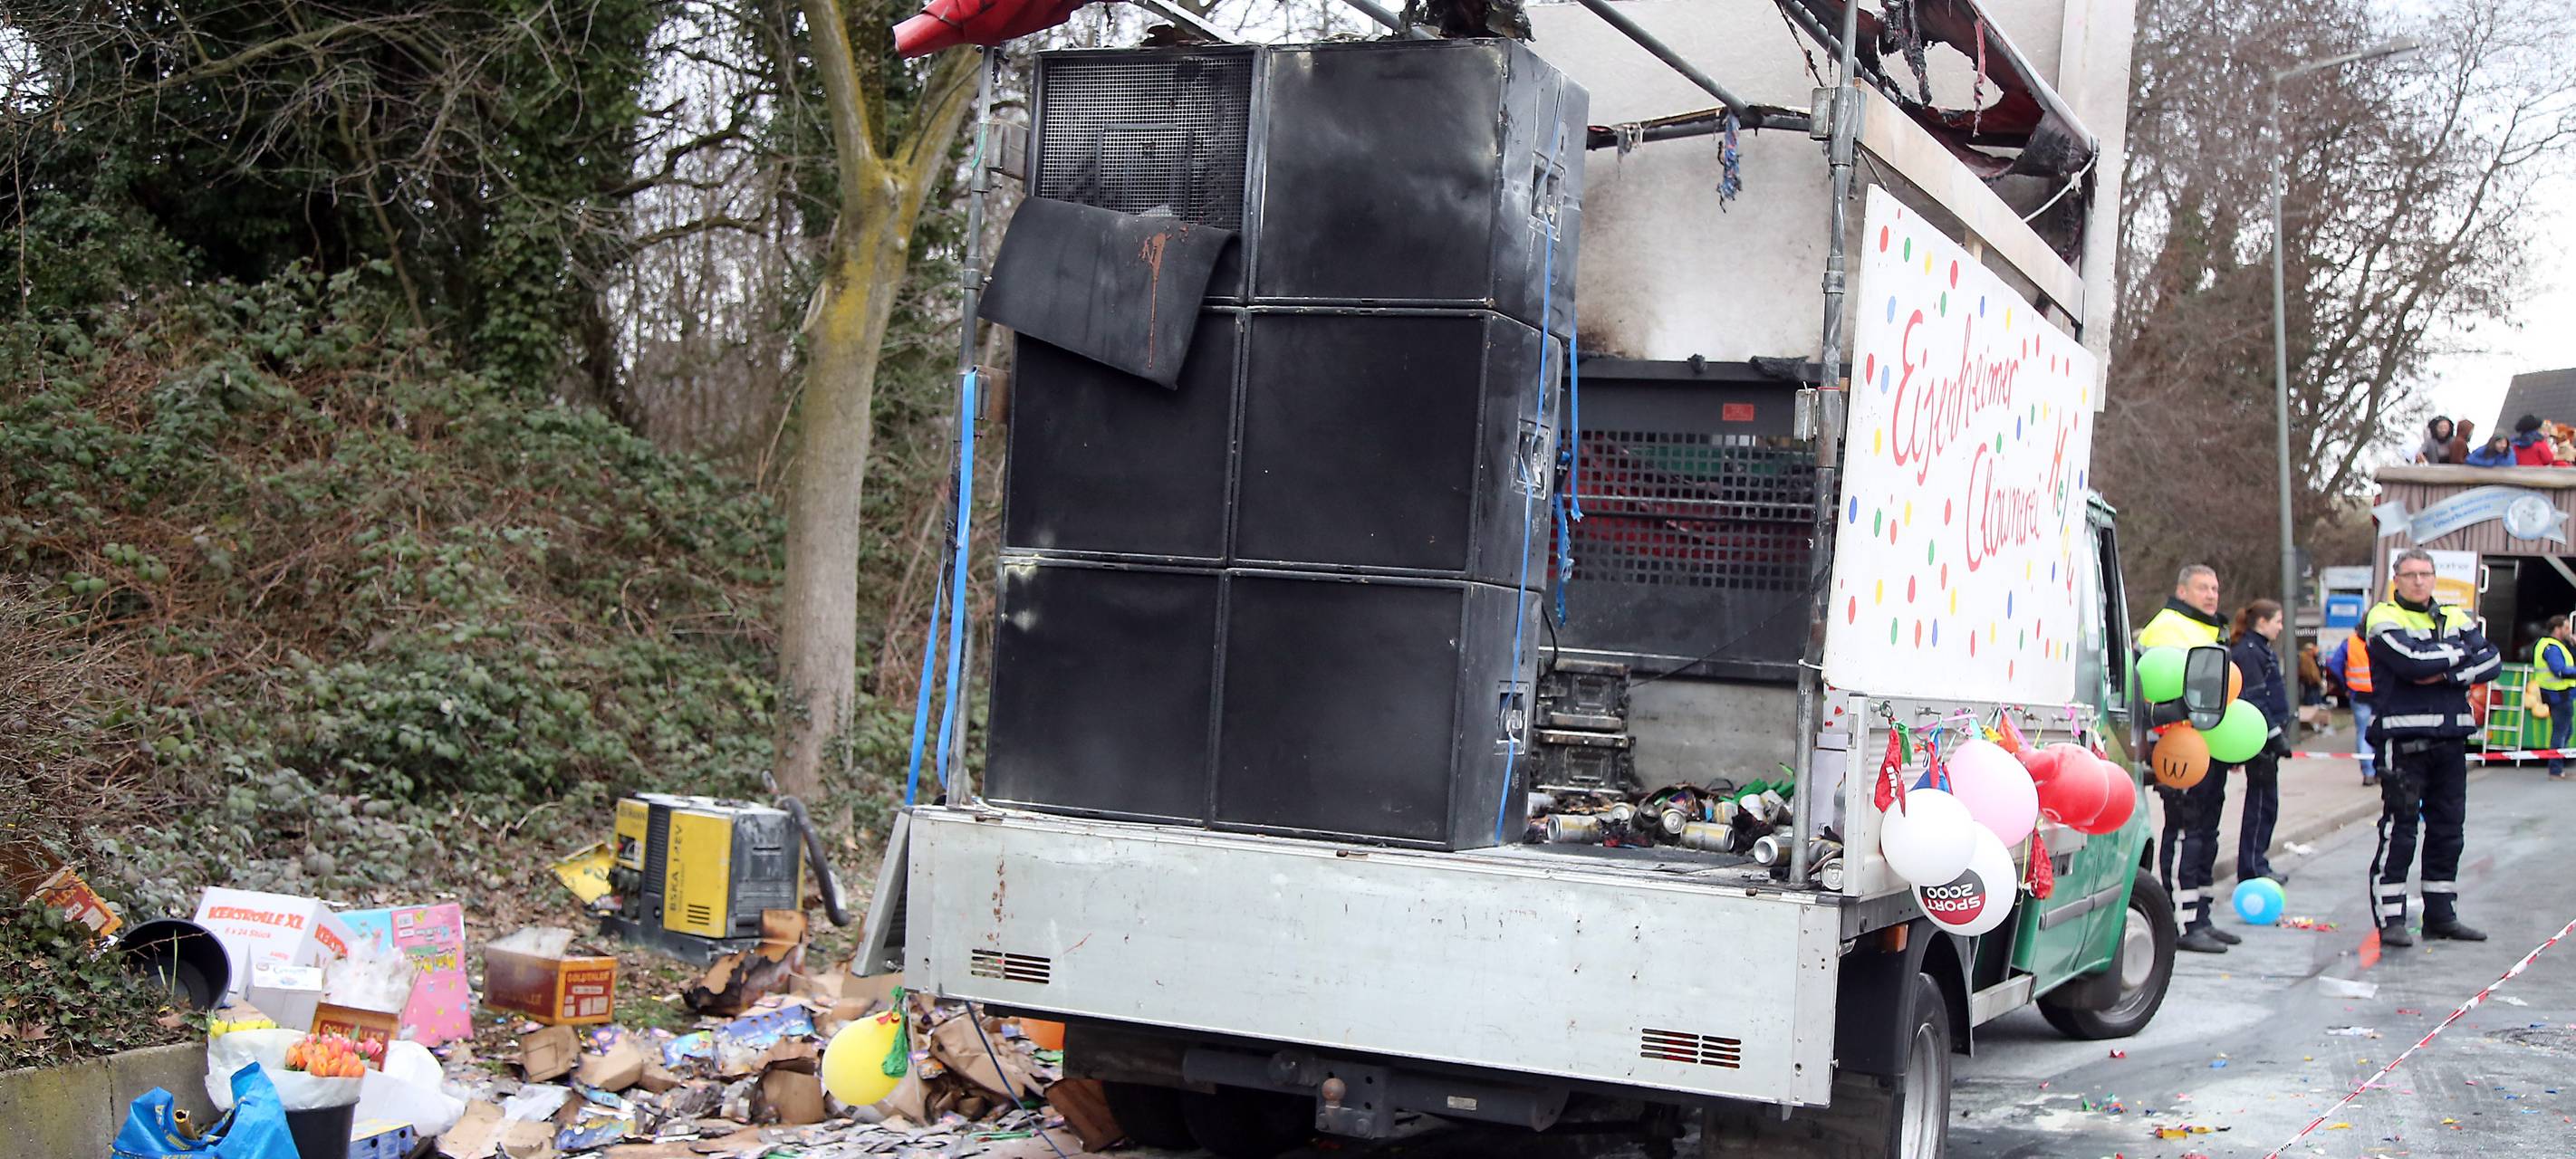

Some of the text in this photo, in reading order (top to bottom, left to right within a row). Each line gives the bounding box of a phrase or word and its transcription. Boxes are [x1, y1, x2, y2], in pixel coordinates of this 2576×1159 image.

[1927, 883, 1974, 899] 2000
[1927, 896, 1981, 912] SPORT
[284, 913, 305, 931] XL
